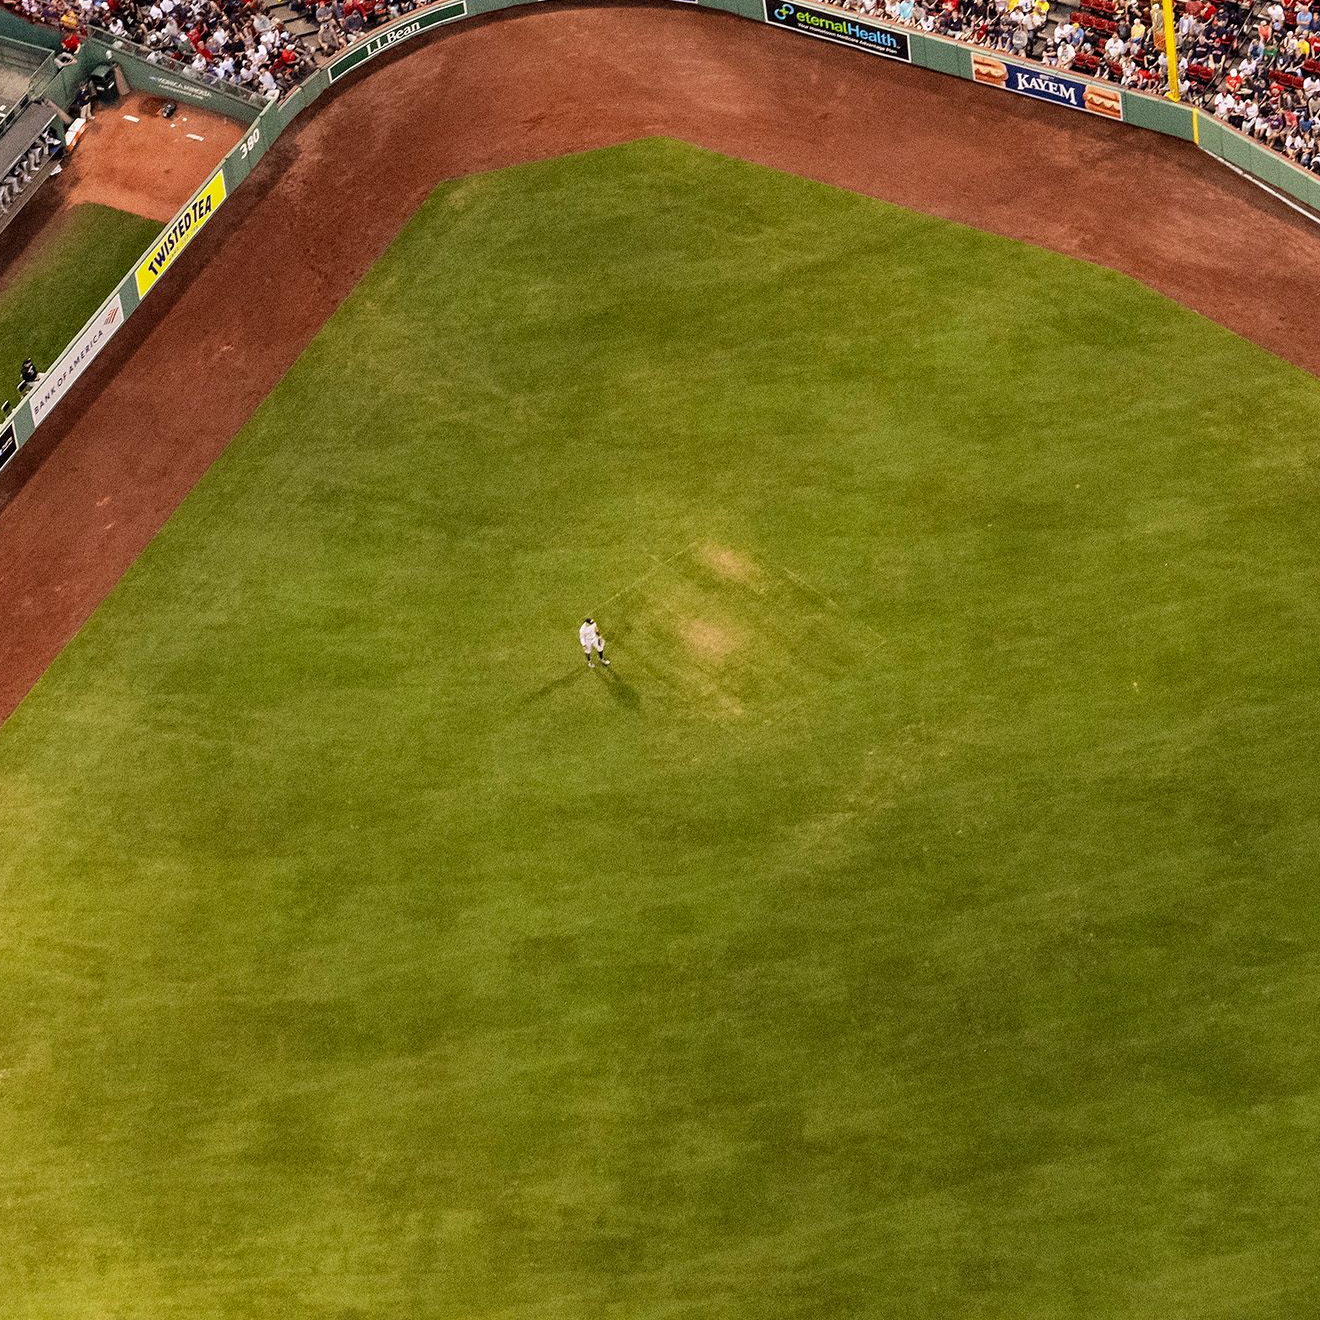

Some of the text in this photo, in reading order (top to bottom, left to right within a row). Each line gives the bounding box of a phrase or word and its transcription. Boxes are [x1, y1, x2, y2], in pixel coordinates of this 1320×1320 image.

[366, 21, 421, 56] L.L.Bean
[796, 11, 897, 47] eternalHealth
[836, 33, 859, 43] Medicare
[1016, 73, 1077, 105] KAYEM
[240, 128, 260, 160] 380
[148, 214, 191, 276] TWISTED
[191, 195, 212, 223] TEA
[34, 330, 104, 415] BANK OF AMERICA
